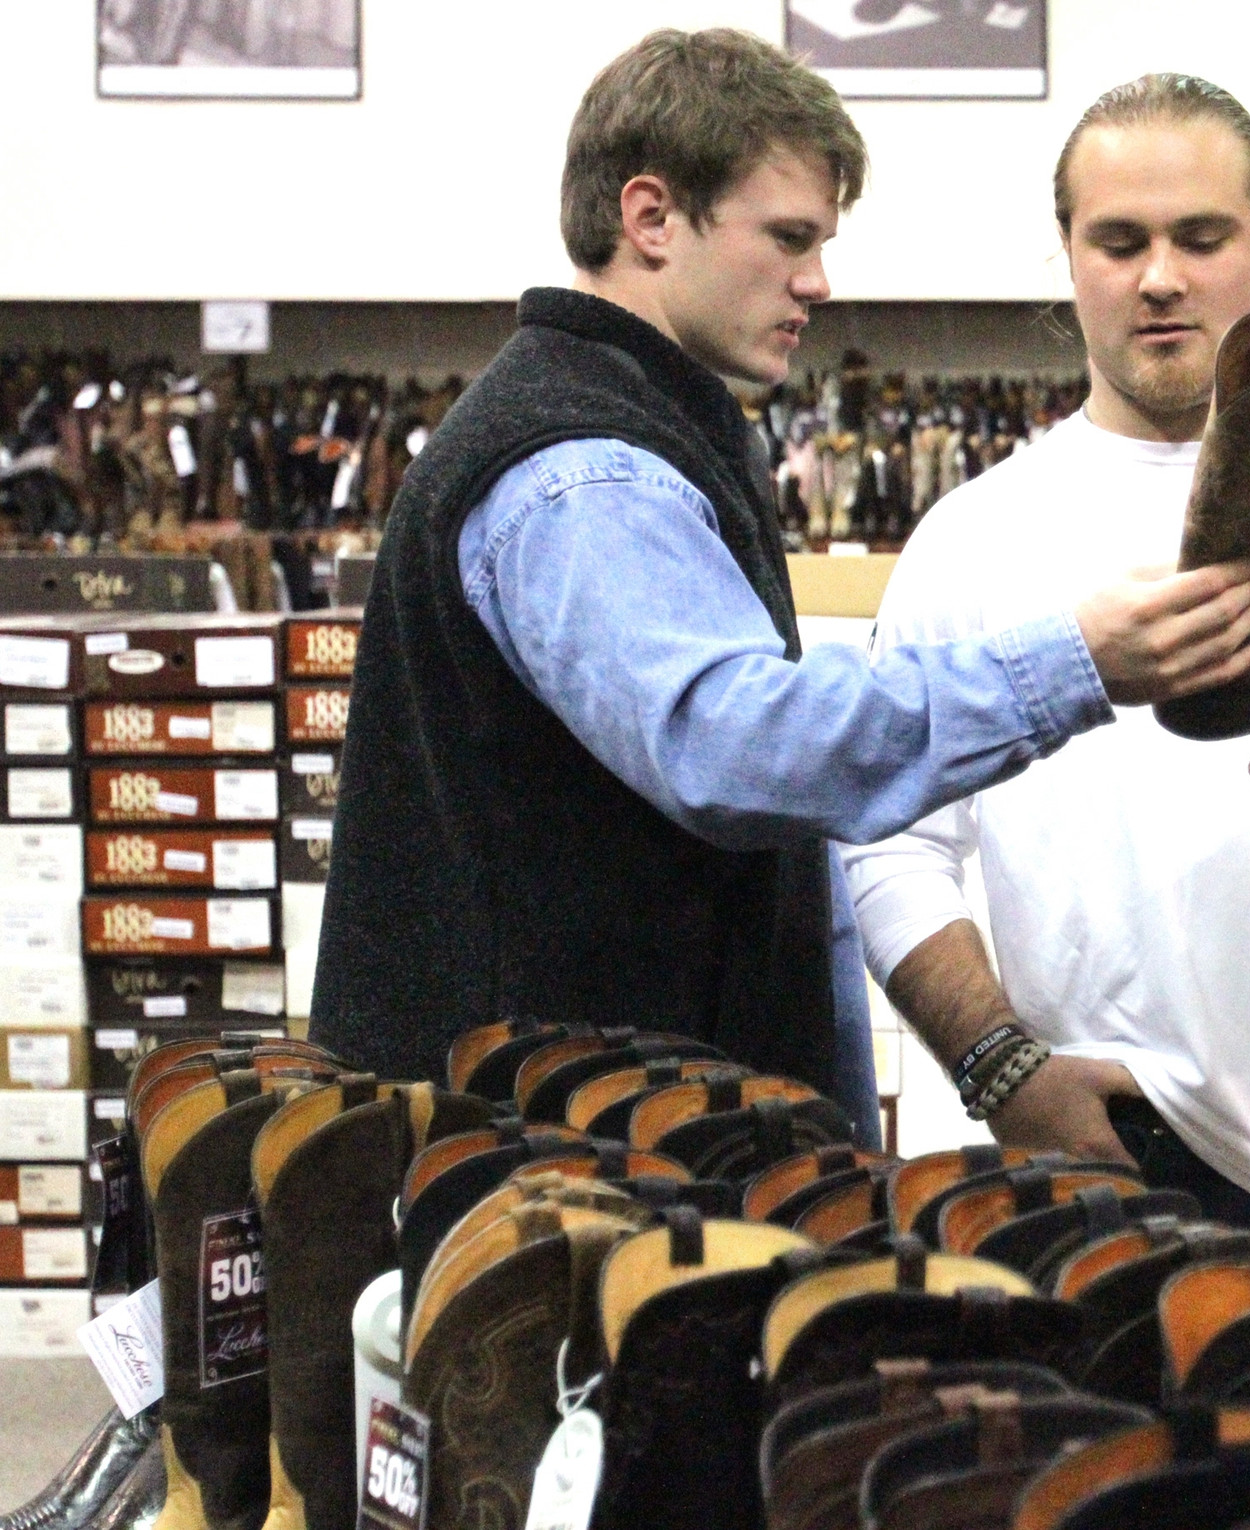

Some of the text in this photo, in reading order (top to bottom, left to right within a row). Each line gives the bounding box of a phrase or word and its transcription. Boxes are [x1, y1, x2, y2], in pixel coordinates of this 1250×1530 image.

[305, 625, 357, 664] 1883
[103, 703, 155, 742] 1883
[105, 834, 158, 874] 1883
[962, 1026, 1012, 1070] UNITED BY
[108, 1324, 153, 1388] Lucchese
[368, 1445, 416, 1507] 50%
